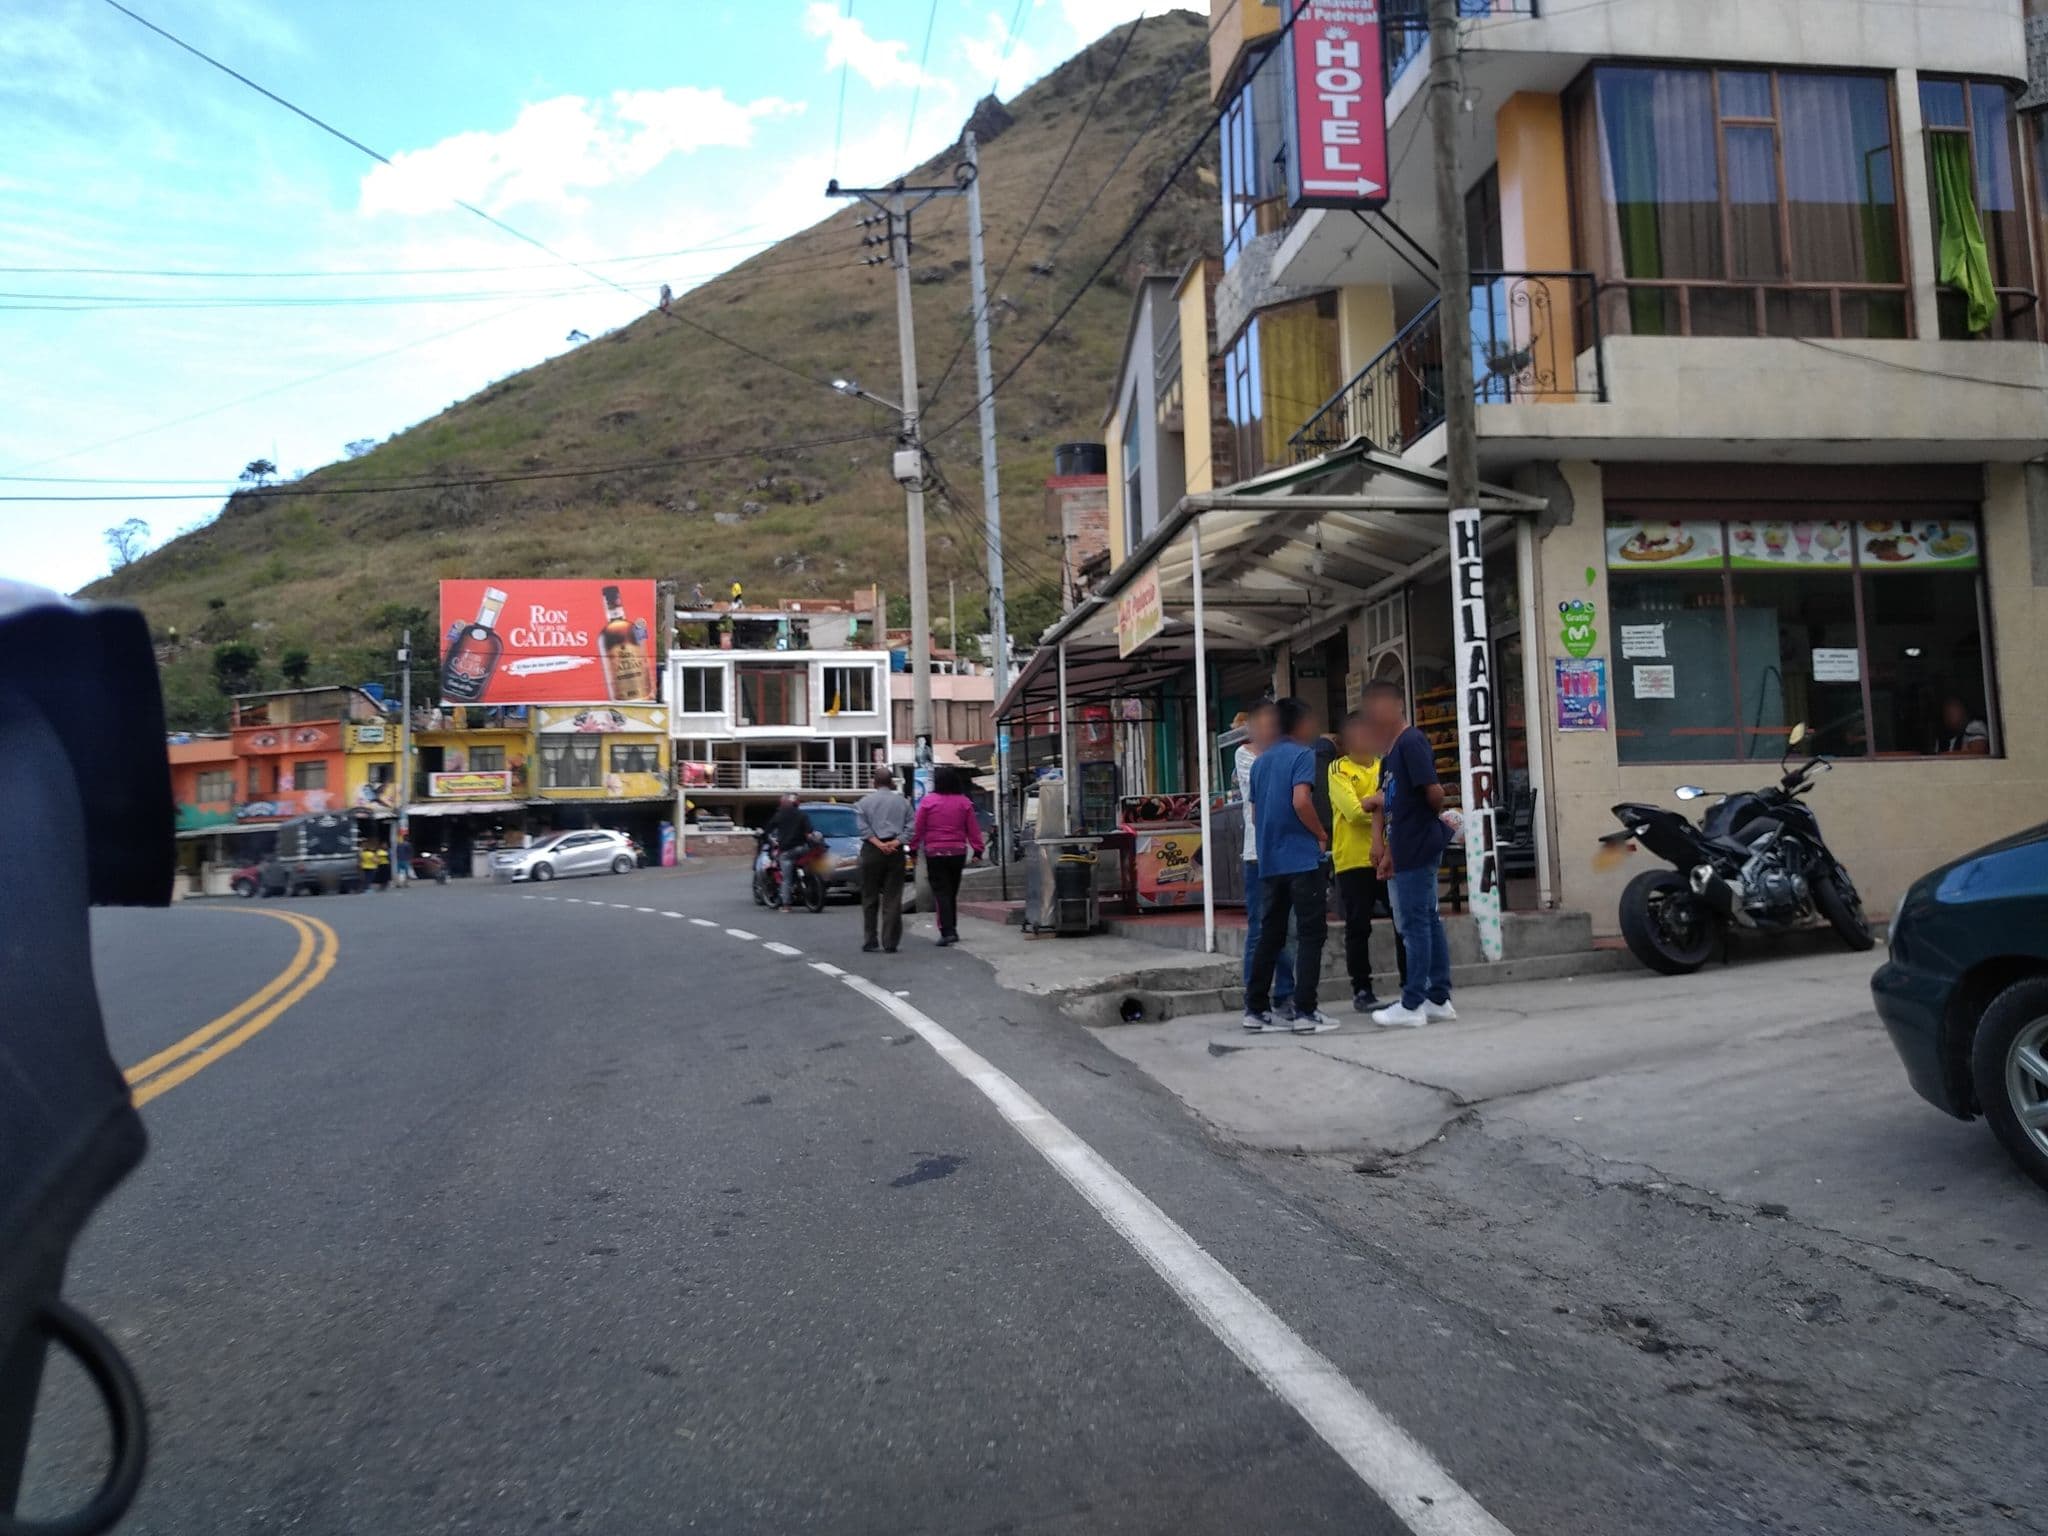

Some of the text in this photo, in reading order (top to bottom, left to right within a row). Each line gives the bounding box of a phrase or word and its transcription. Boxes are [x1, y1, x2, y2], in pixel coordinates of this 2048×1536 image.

[1314, 8, 1378, 25] Pedregal
[1315, 39, 1362, 171] HOTEL
[1565, 613, 1590, 622] Gratis
[510, 627, 589, 647] CALDAS
[1455, 519, 1498, 894] HELADERIA
